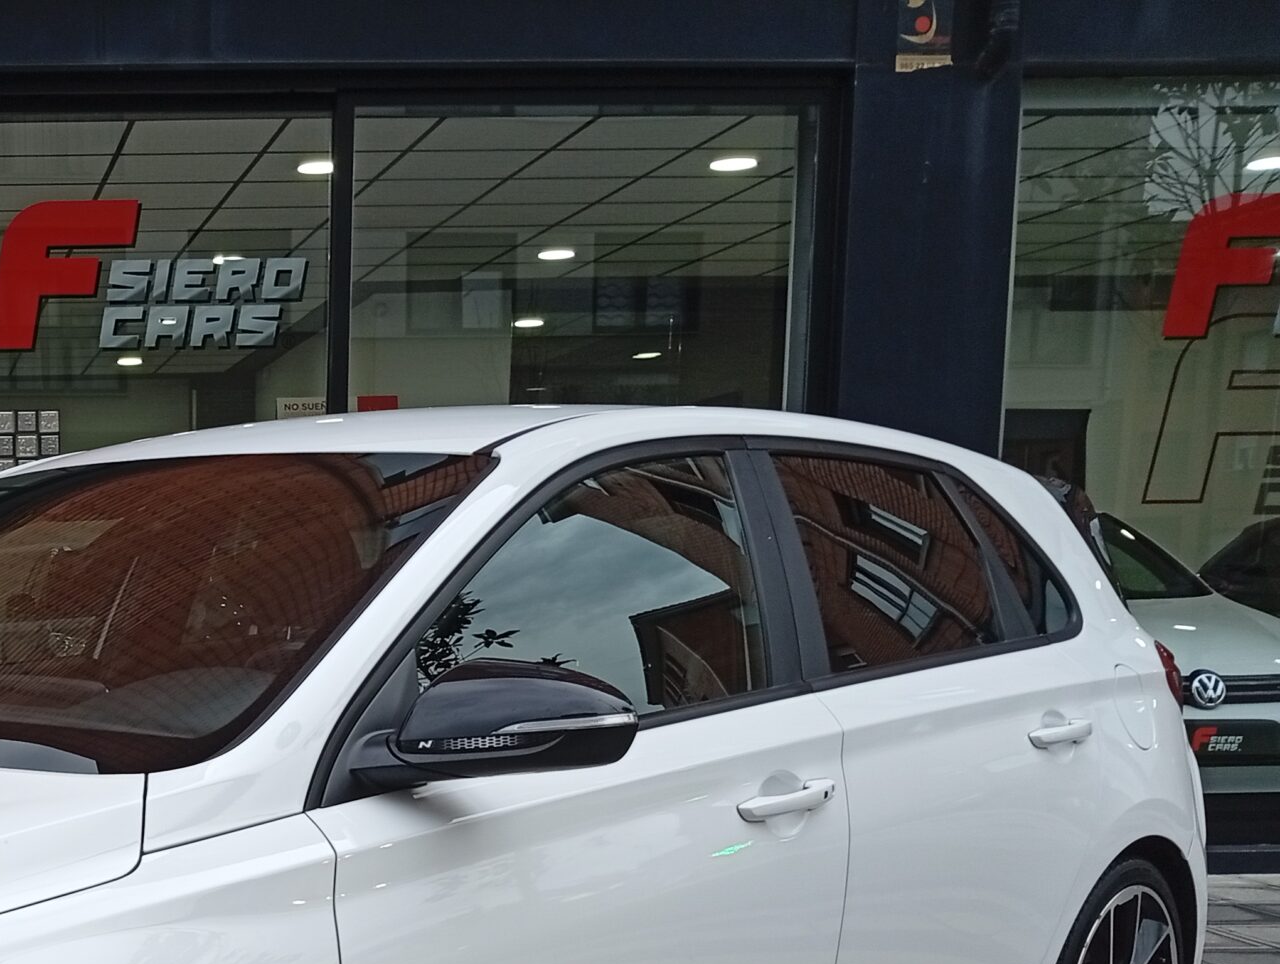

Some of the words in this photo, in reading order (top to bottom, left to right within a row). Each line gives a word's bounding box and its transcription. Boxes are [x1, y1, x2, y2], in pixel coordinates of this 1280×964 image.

[107, 257, 308, 303] SIERO
[99, 304, 282, 350] CARS
[284, 402, 299, 411] NO
[1209, 735, 1244, 743] SIERO
